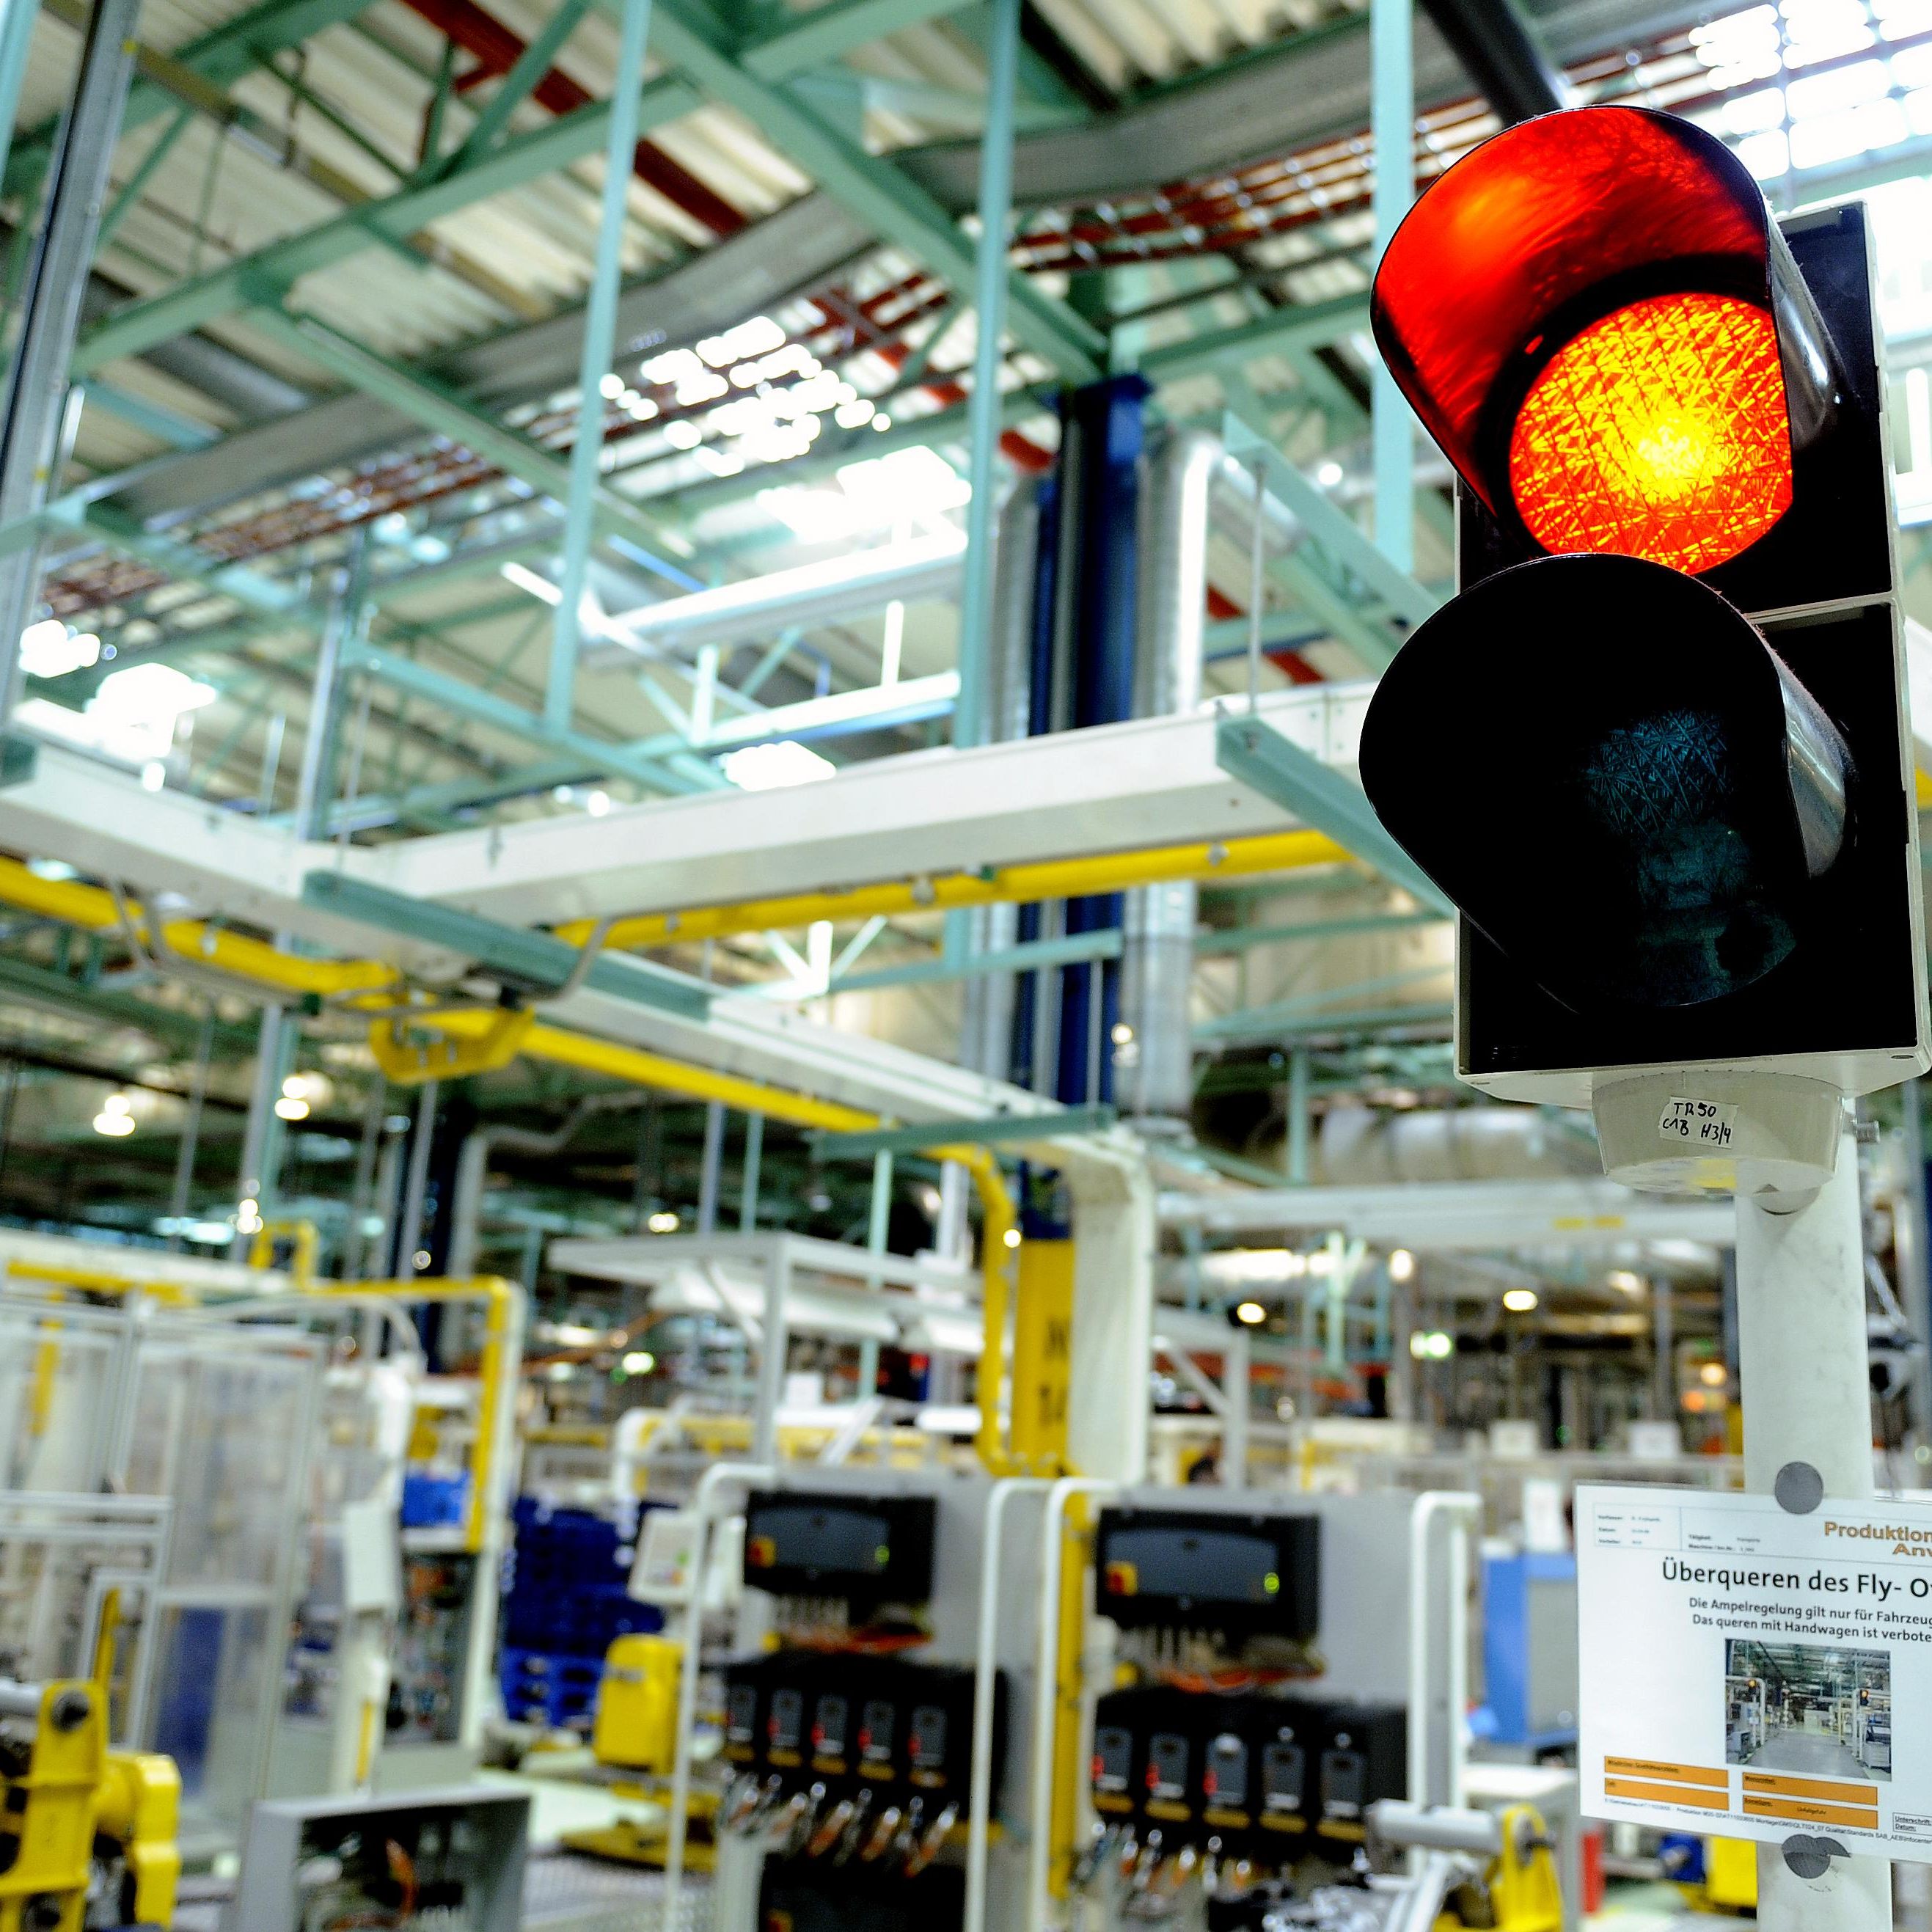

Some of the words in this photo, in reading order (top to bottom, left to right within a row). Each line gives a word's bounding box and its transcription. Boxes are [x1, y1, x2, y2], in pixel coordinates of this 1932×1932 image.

[1663, 1556, 1801, 1591] Überqueren
[1808, 1570, 1848, 1592] des
[1858, 1573, 1902, 1602] Fly-
[1689, 1597, 1708, 1609] Die
[1711, 1599, 1802, 1620] Ampelregelung
[1806, 1606, 1826, 1620] gilt
[1829, 1609, 1851, 1620] nur
[1854, 1609, 1873, 1620] für
[1693, 1614, 1713, 1625] Das
[1716, 1617, 1757, 1630] queren
[1761, 1620, 1781, 1631] mit
[1785, 1621, 1859, 1639] Handwagen
[1863, 1626, 1878, 1639] ist
